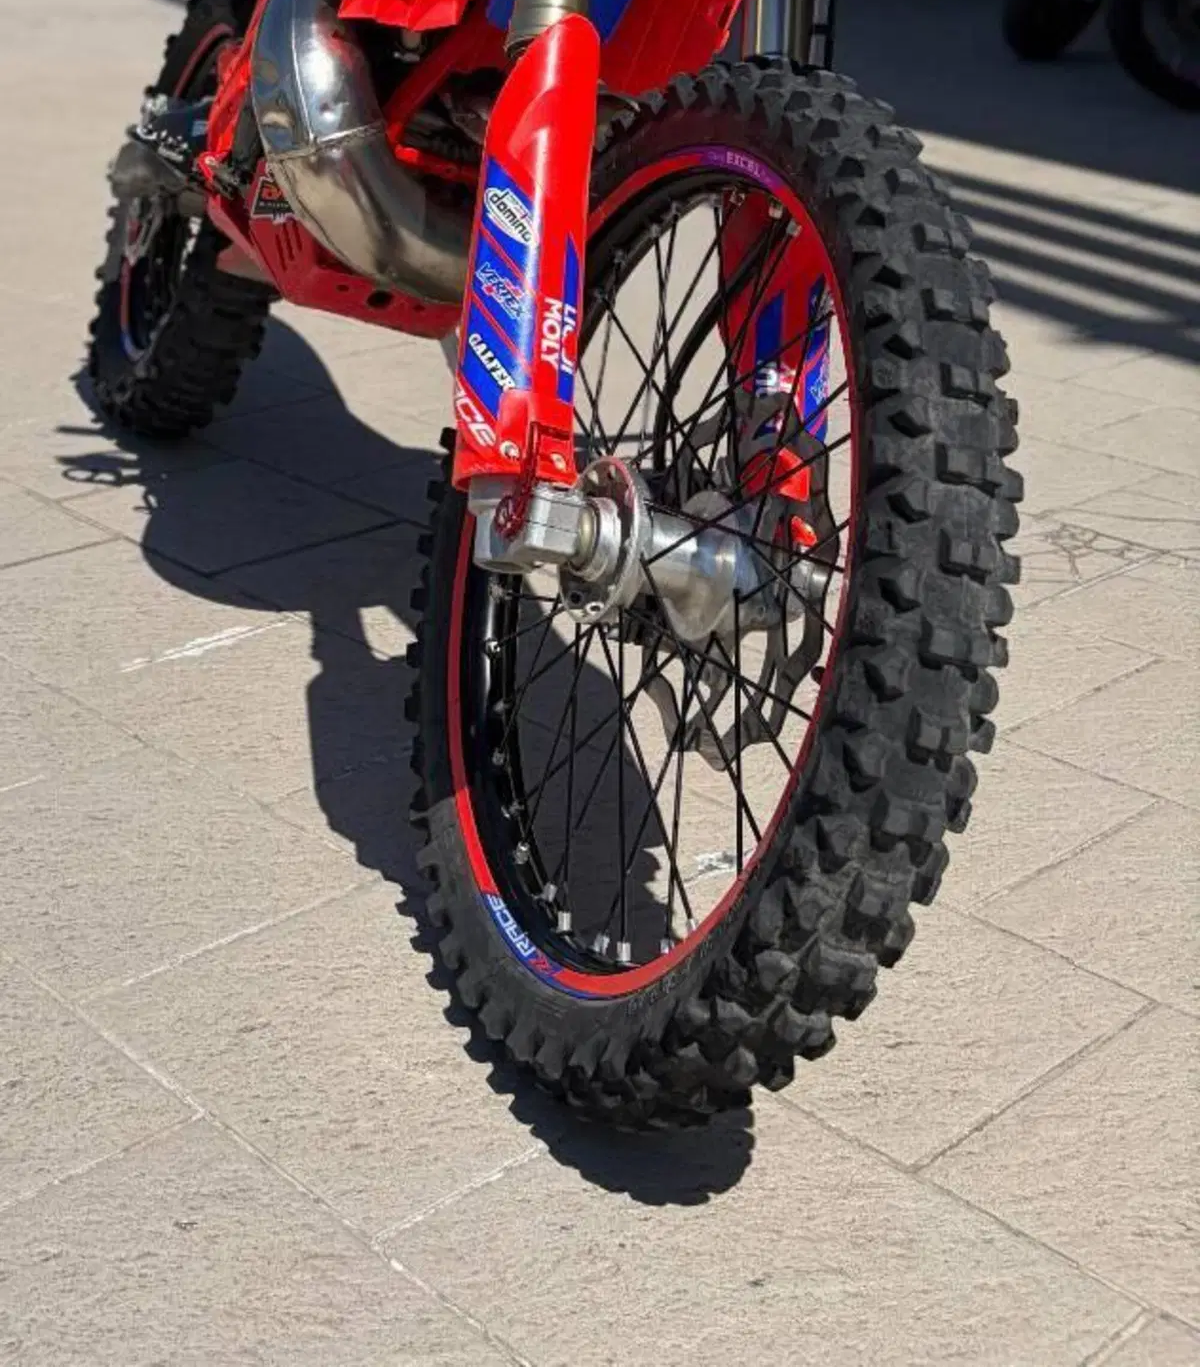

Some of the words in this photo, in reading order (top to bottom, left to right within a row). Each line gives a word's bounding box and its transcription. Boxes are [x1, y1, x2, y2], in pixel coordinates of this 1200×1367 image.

[488, 190, 533, 243] domino
[477, 263, 525, 319] VERTEX
[468, 332, 517, 391] GALFER
[541, 297, 563, 371] MOLY
[487, 894, 537, 957] RACE
